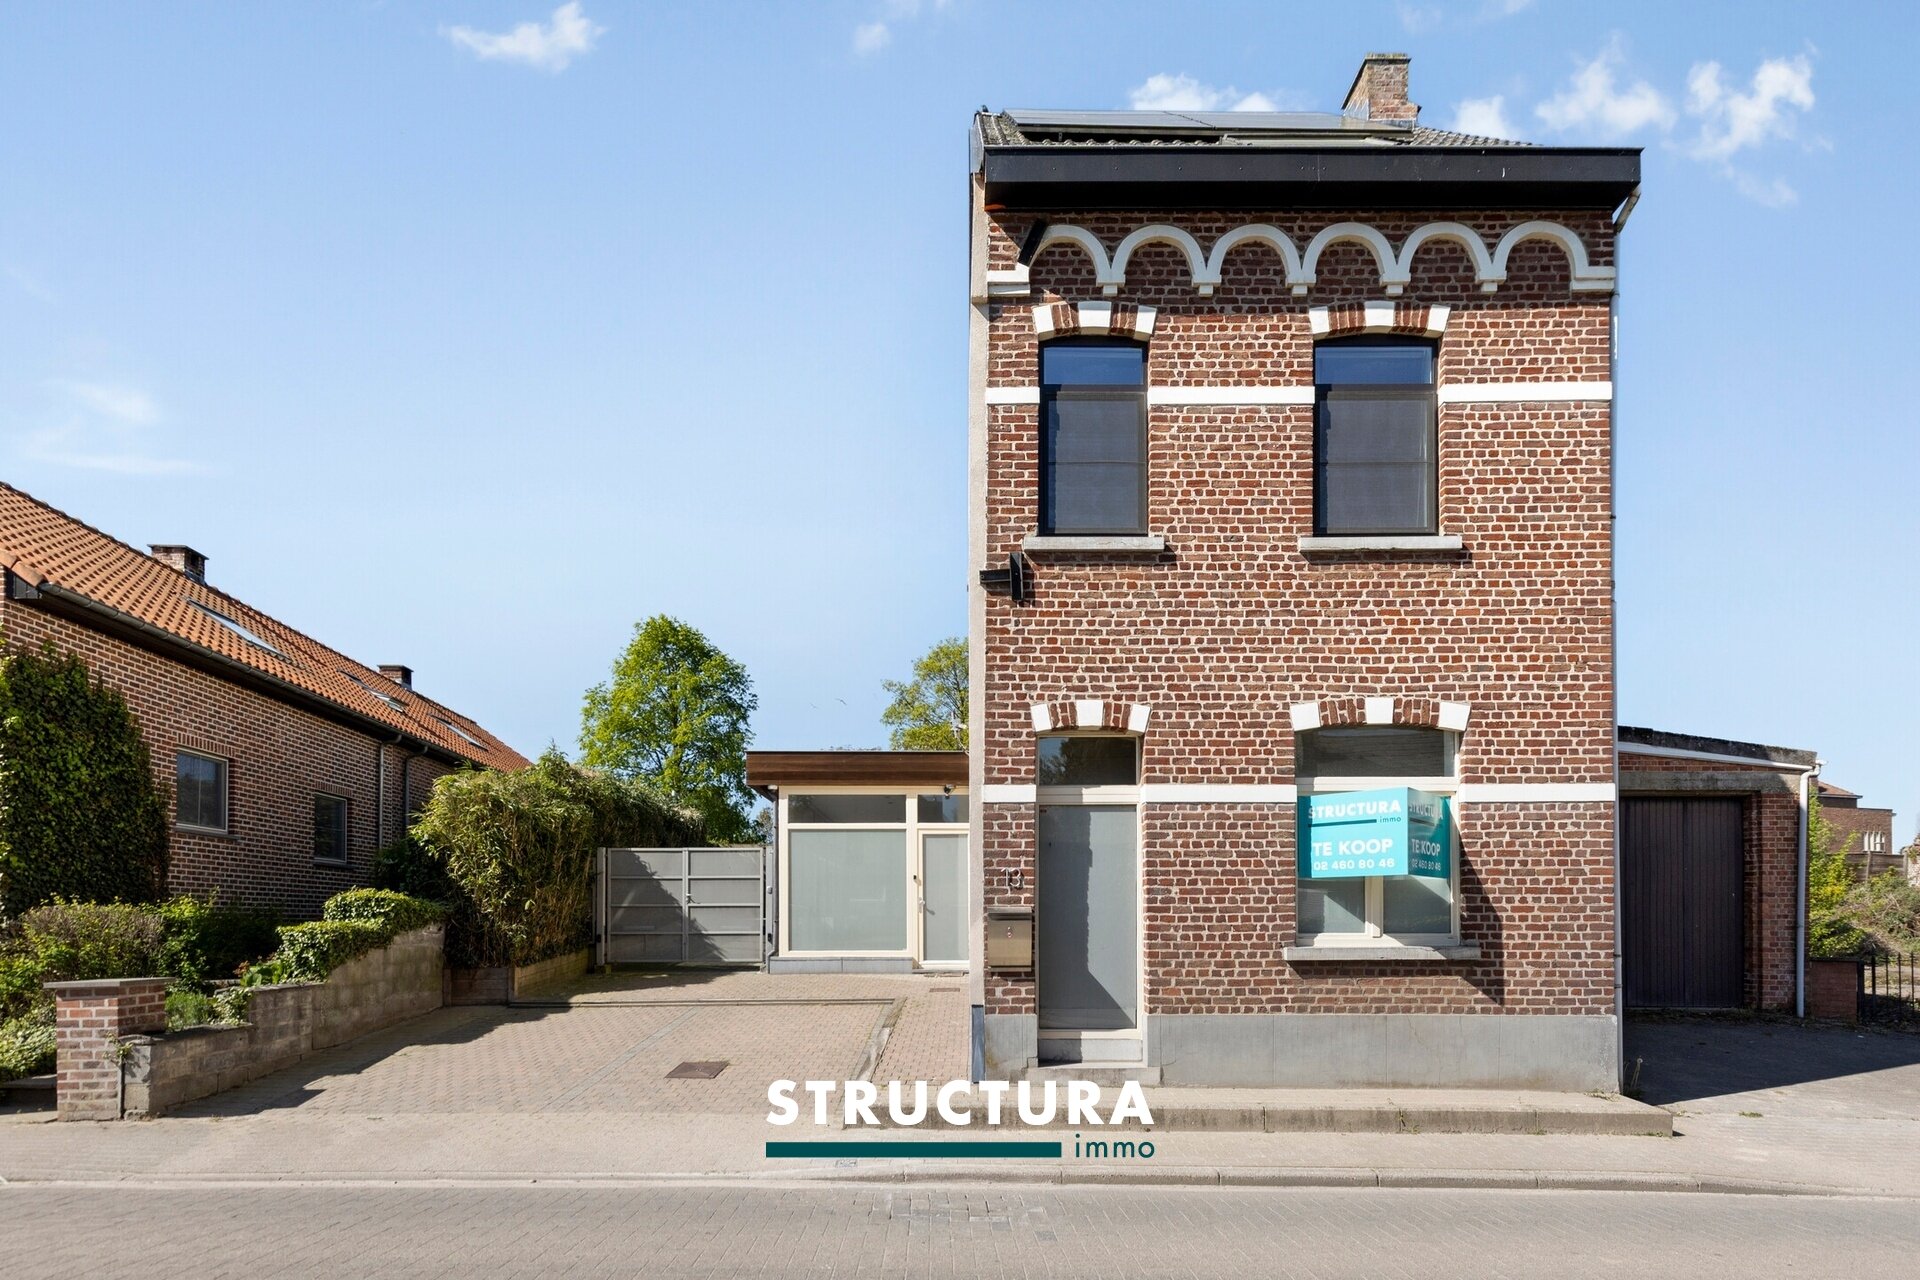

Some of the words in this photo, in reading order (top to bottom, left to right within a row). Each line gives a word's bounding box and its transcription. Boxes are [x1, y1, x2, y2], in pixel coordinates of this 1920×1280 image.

[1308, 800, 1402, 819] STRUCTURA
[1409, 803, 1444, 819] STRUCTUA
[1312, 842, 1332, 856] TE
[1338, 839, 1393, 855] KOOP
[1411, 839, 1420, 853] TE
[1421, 841, 1441, 856] KOOP
[1313, 861, 1328, 871] 02
[1331, 859, 1355, 869] 460
[1358, 859, 1375, 869] 80
[1378, 857, 1395, 868] 46
[1000, 868, 1021, 887] 13
